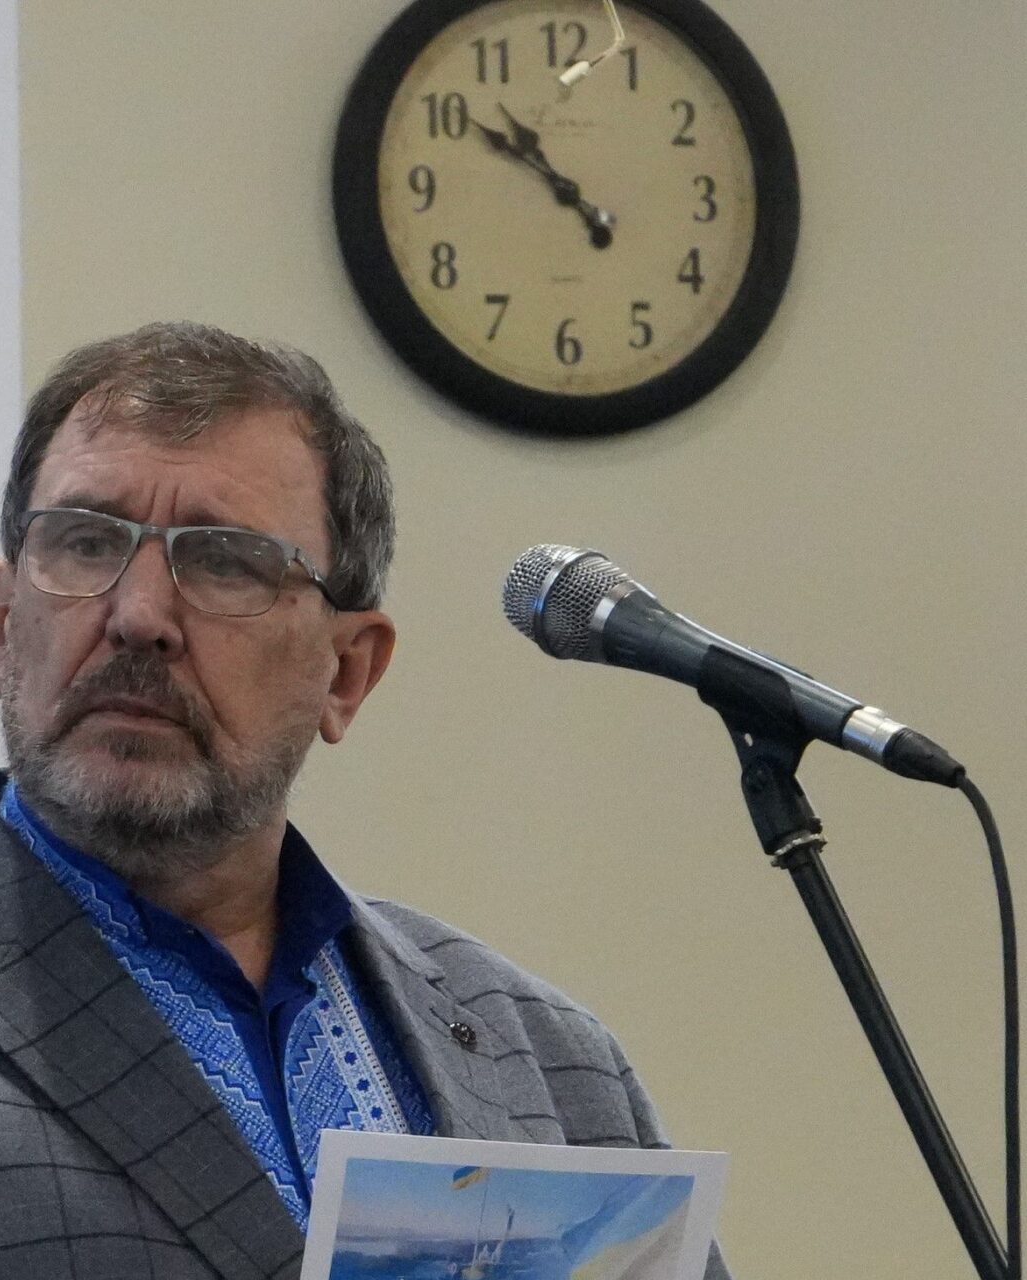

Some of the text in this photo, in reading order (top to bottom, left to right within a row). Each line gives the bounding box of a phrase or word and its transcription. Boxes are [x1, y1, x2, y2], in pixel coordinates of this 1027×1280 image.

[473, 38, 511, 84] 11
[540, 22, 588, 68] 12
[620, 46, 639, 91] 1
[422, 92, 469, 140] 10
[671, 100, 697, 147] 2
[408, 165, 437, 213] 9
[692, 175, 718, 223] 3
[431, 242, 458, 290] 8
[677, 248, 705, 294] 4
[485, 294, 511, 342] 7
[629, 302, 653, 350] 5
[555, 319, 583, 366] 6
